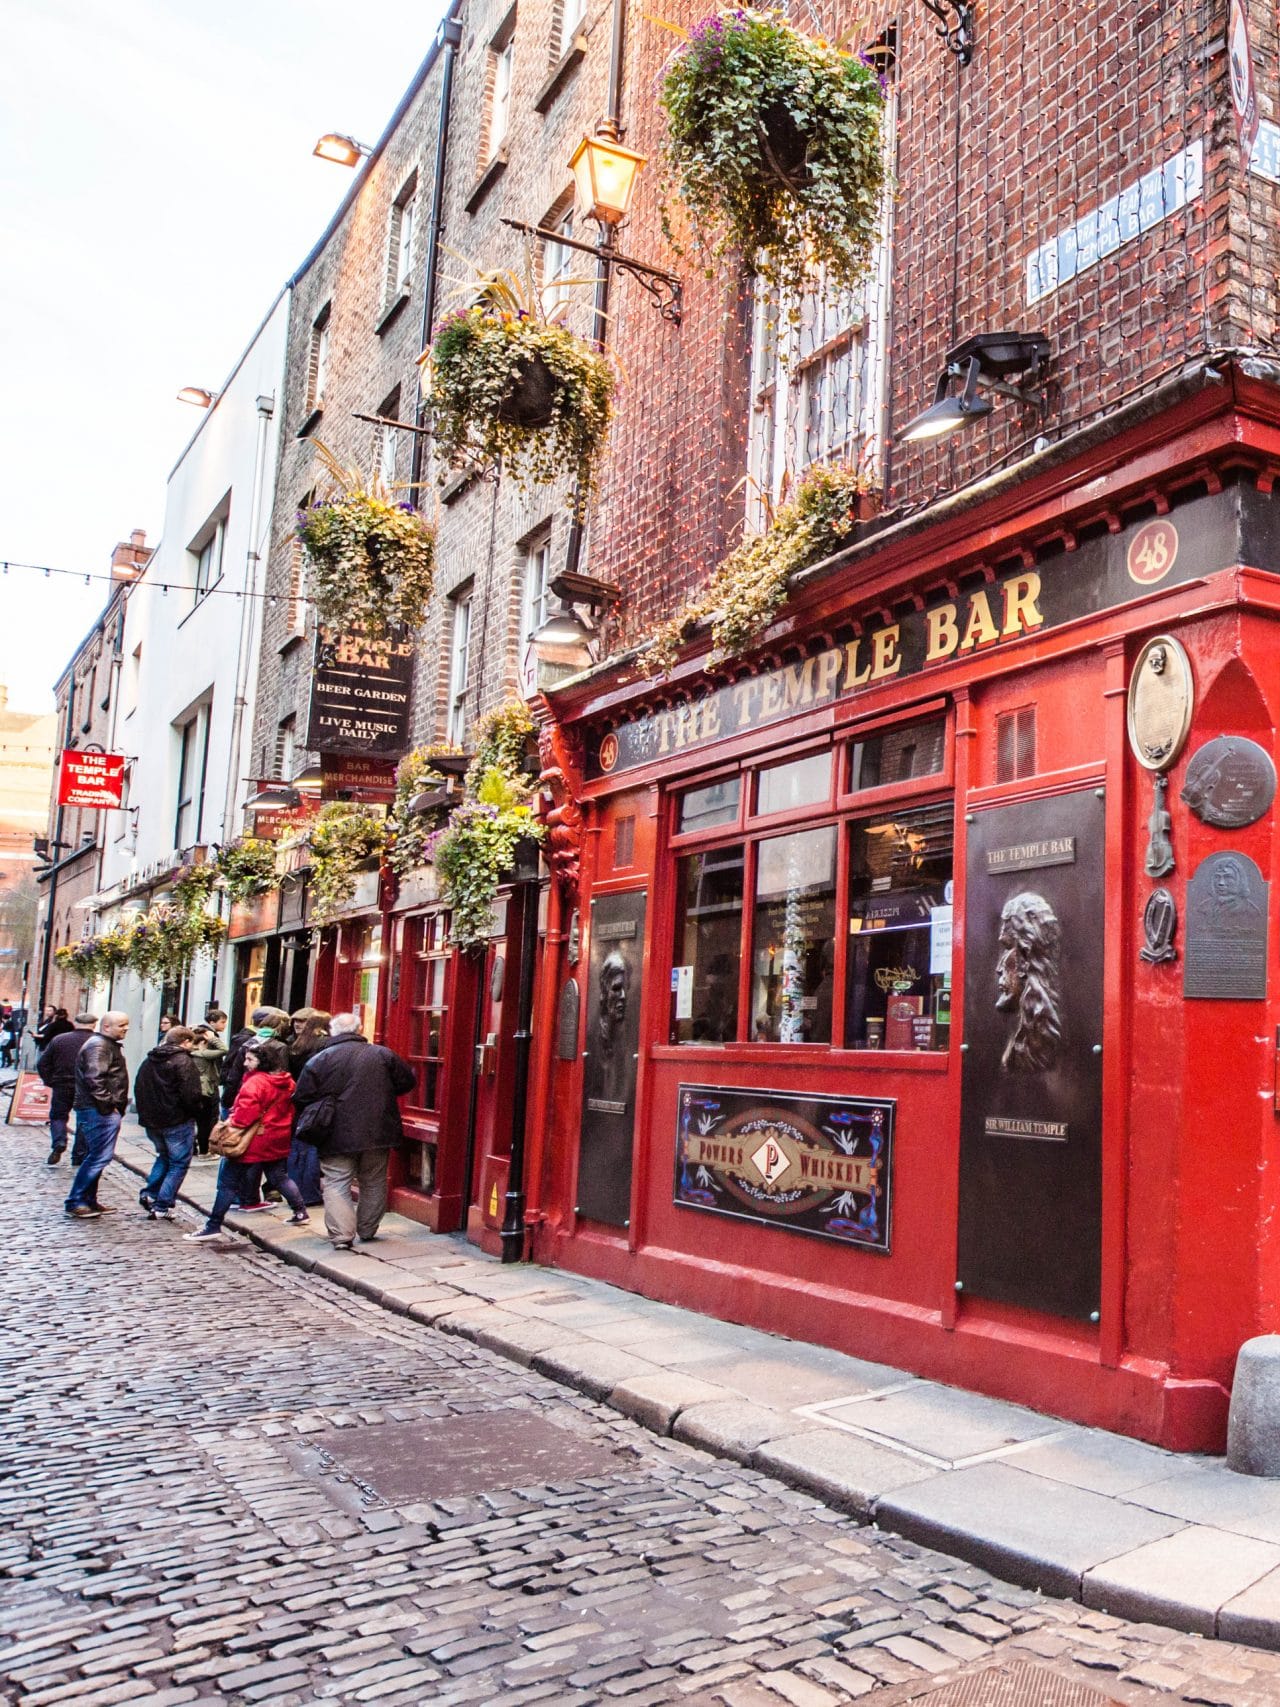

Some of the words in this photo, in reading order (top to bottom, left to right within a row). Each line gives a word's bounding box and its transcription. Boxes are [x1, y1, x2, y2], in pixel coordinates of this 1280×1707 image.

[1077, 229, 1120, 263] TEMPLE
[1128, 205, 1156, 231] BAR
[1136, 531, 1167, 575] 48
[655, 699, 720, 753] THE
[734, 624, 902, 726] TEMPLE
[926, 572, 1044, 661] BAR
[316, 683, 351, 695] BEER
[354, 688, 407, 703] GARDEN
[319, 716, 351, 728] LIVE
[355, 720, 398, 733] MUSIC
[340, 728, 380, 740] DAILY
[81, 755, 107, 766] THE
[346, 763, 370, 771] BAR
[67, 764, 119, 777] TEMPLE
[324, 773, 393, 785] MERCHANDISE
[77, 775, 105, 786] BAR
[986, 850, 1006, 864] THE
[1009, 843, 1048, 860] TEMPLE
[1050, 839, 1073, 854] BAR
[985, 1119, 998, 1130] SIR
[999, 1120, 1032, 1133] WILLIAM
[1033, 1122, 1065, 1136] TEMPLE
[700, 1141, 743, 1166] POWERS
[800, 1153, 863, 1184] WHISKEY
